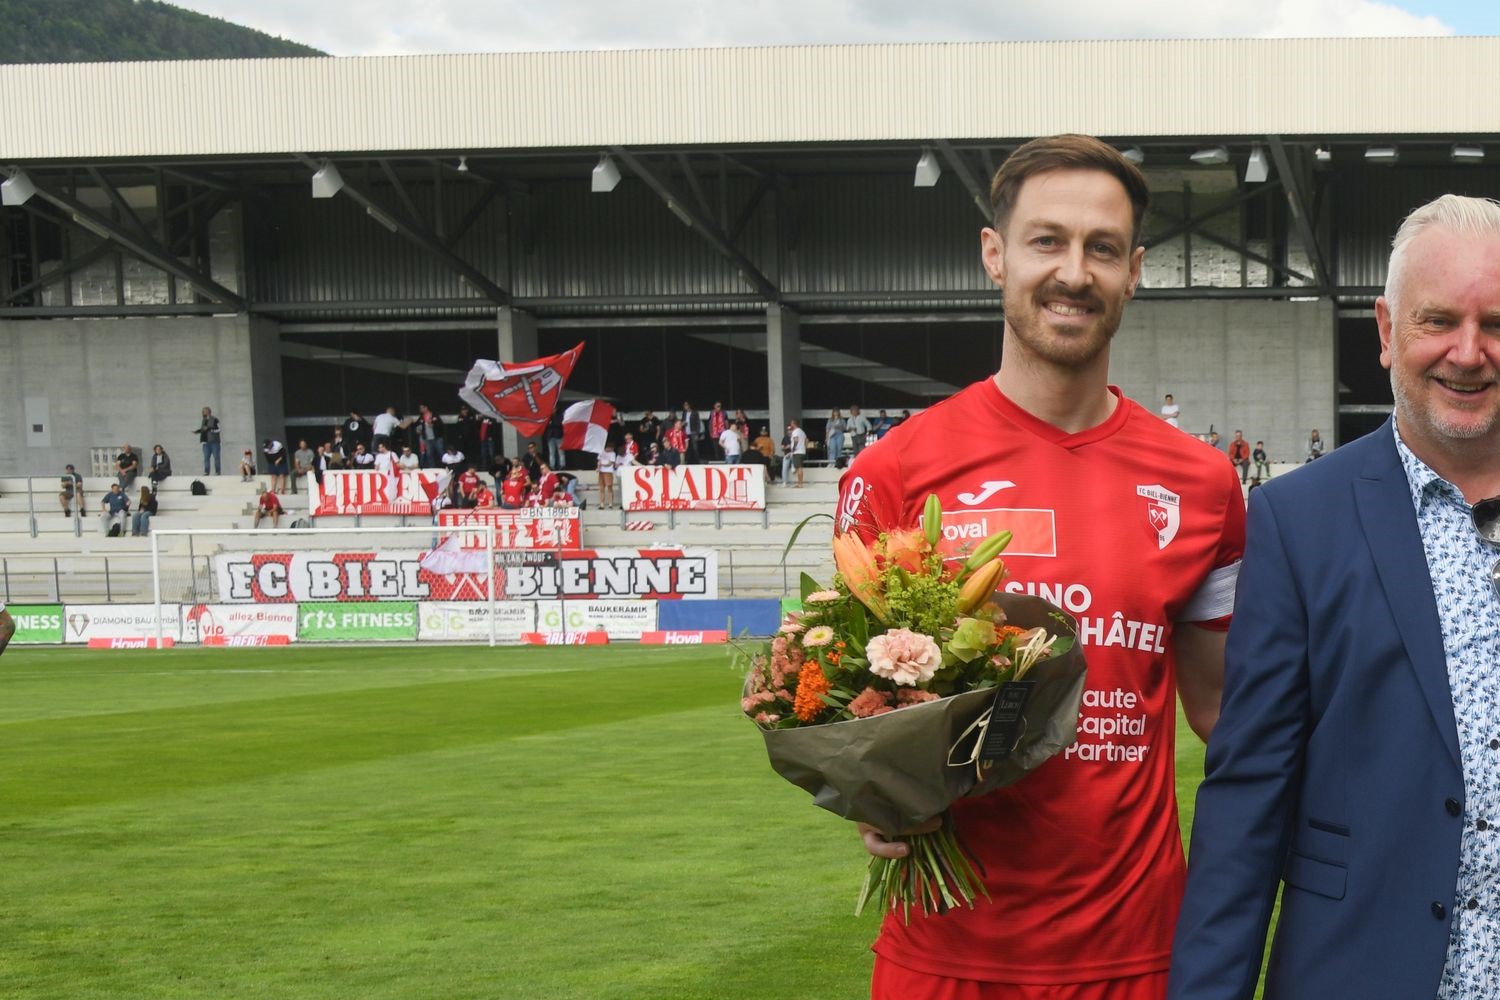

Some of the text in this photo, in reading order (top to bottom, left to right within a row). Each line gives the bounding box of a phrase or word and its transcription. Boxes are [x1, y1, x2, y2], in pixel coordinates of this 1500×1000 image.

[634, 467, 753, 501] STADT
[548, 508, 569, 518] 1896
[941, 518, 987, 541] oval
[228, 560, 431, 599] FC BIEL
[505, 557, 706, 596] BIENNE
[229, 611, 293, 622] allez Bienne
[588, 605, 648, 614] BAUKERAMIK
[12, 614, 61, 630] NESS
[93, 615, 133, 625] DIAMOND
[135, 616, 152, 625] BAU
[342, 612, 414, 628] FITNESS
[203, 625, 224, 635] vip
[665, 631, 703, 645] Hoval
[1077, 611, 1165, 654] HÂTEL
[1082, 687, 1137, 709] aute
[1064, 741, 1150, 762] Partner
